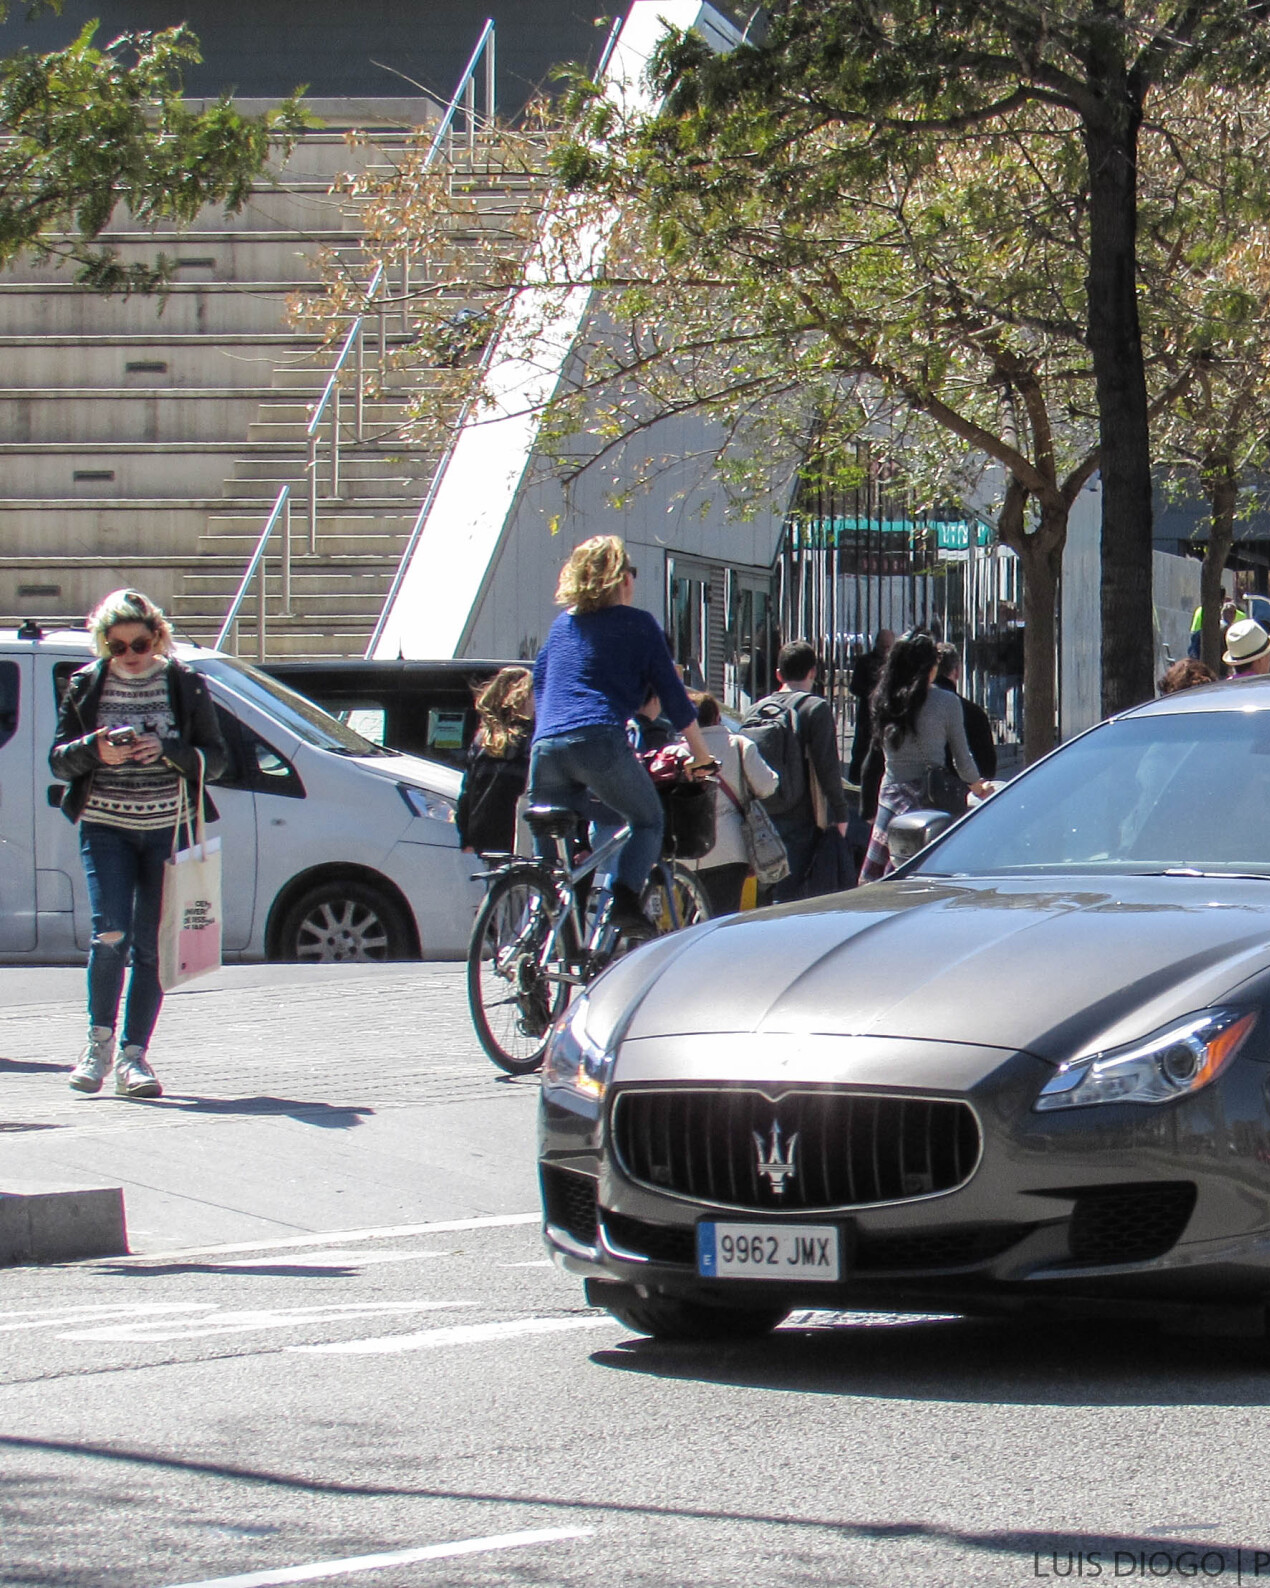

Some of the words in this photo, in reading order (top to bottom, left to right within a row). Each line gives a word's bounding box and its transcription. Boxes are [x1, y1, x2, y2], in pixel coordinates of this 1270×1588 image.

[703, 1254, 712, 1266] E
[721, 1234, 779, 1265] 9962
[787, 1237, 830, 1266] JMX
